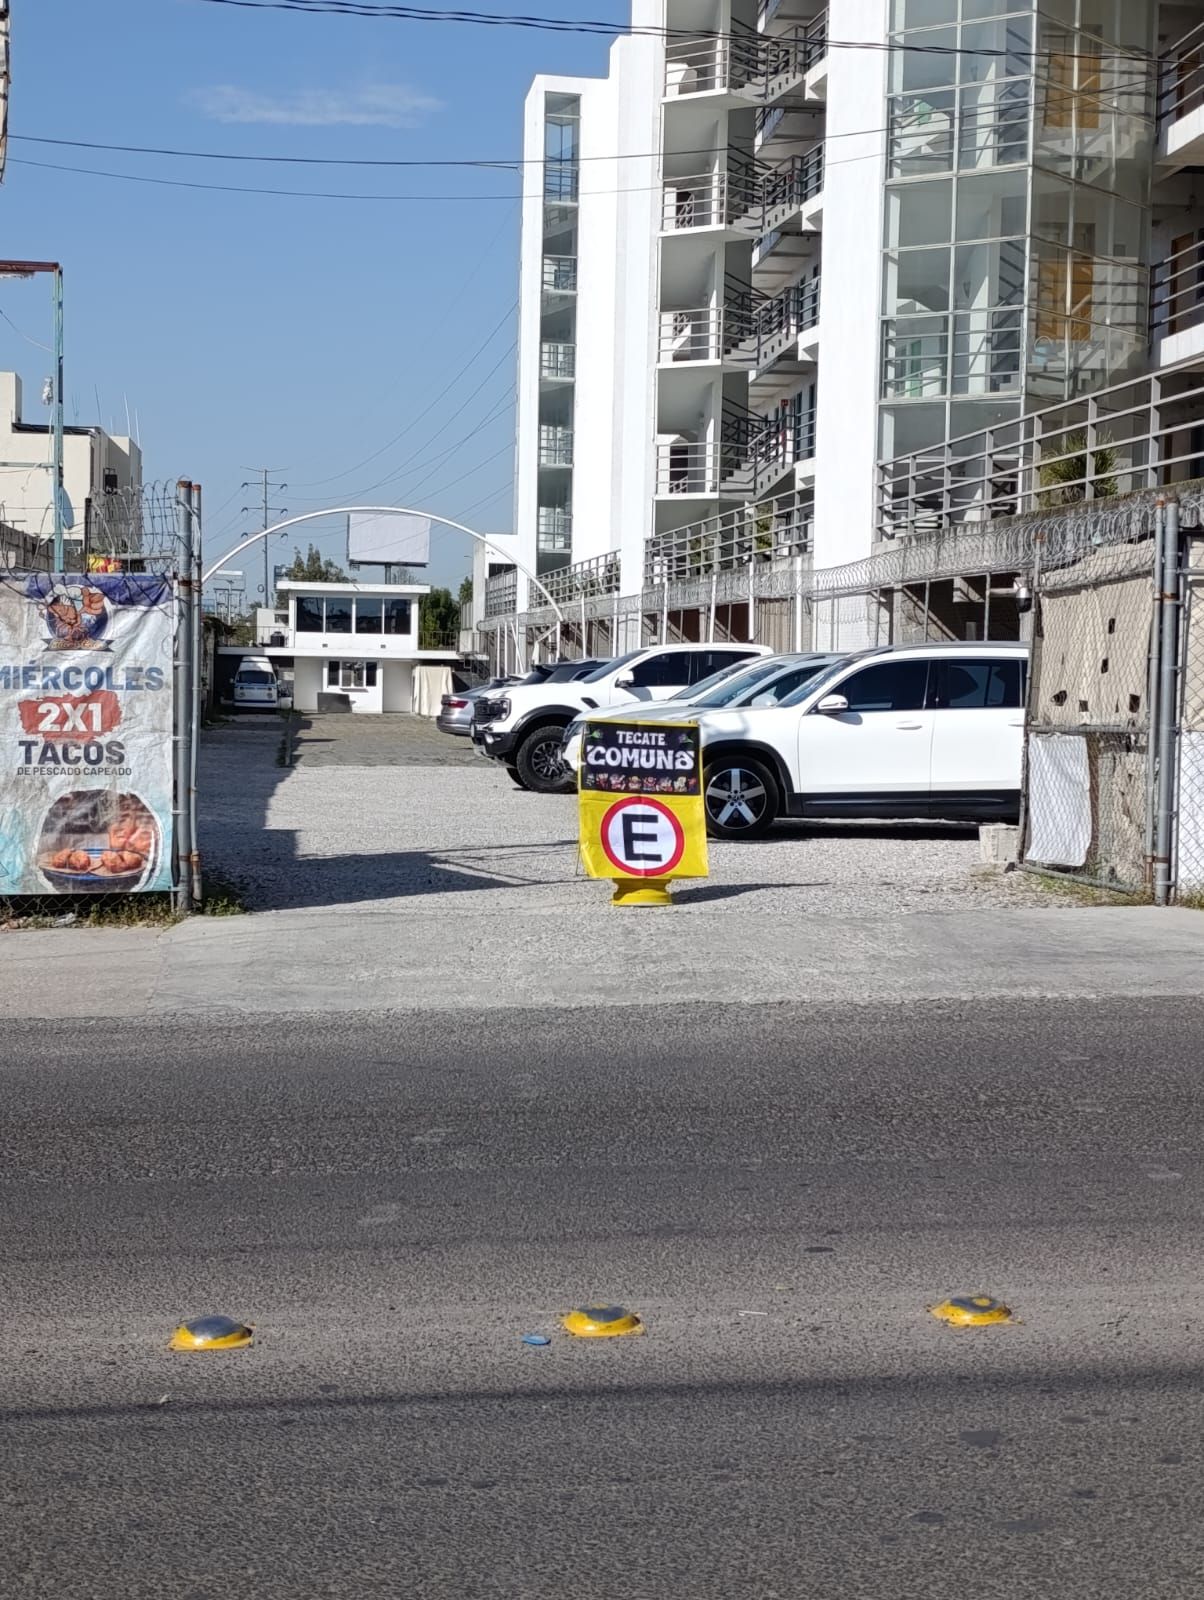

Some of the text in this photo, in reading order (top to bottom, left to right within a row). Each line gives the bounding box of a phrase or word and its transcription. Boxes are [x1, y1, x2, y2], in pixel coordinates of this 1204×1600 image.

[37, 702, 103, 732] 2X1
[616, 730, 666, 746] TECATE
[18, 740, 125, 766] TACOS
[17, 767, 132, 776] DE PESCADO CAPEADO
[622, 813, 662, 862] E
